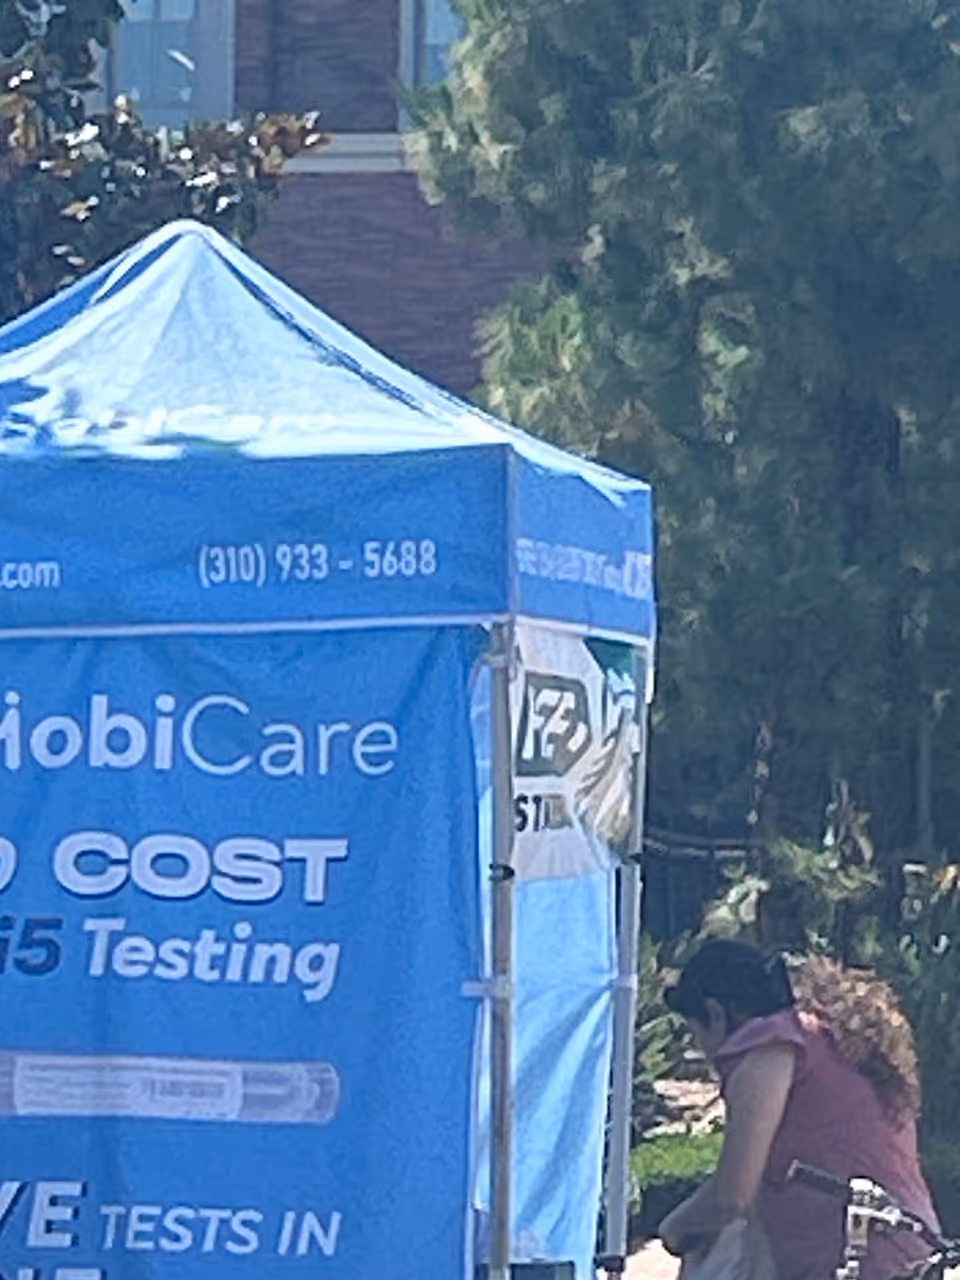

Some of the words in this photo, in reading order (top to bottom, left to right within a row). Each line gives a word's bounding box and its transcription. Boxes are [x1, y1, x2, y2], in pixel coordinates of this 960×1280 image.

[199, 544, 266, 588] (310)
[275, 543, 329, 581] 933
[363, 539, 437, 577] 5688
[53, 830, 349, 903] COST
[82, 917, 339, 1001] Testing
[100, 1204, 262, 1254] TESTS
[278, 1210, 341, 1256] IN
